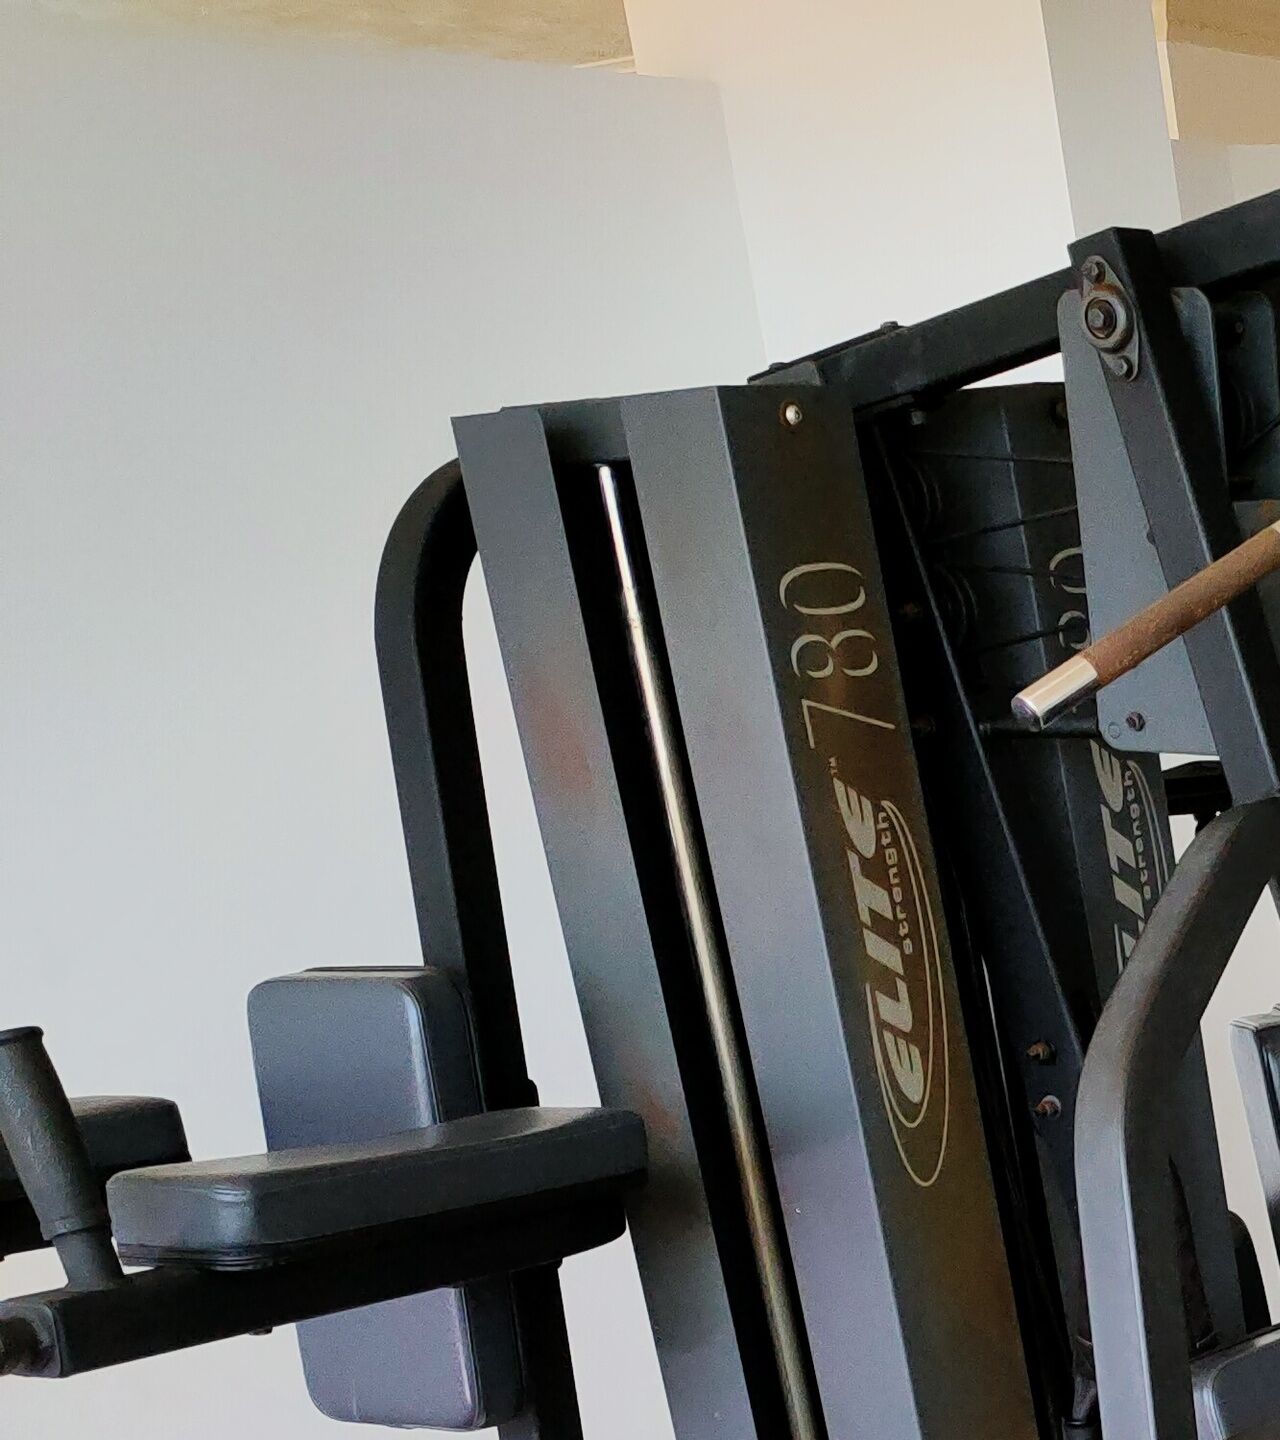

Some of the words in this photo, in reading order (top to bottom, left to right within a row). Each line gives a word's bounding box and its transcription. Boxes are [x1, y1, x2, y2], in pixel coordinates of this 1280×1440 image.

[779, 560, 896, 750] 780
[876, 808, 913, 956] strength
[1090, 738, 1145, 958] LITE
[1123, 770, 1152, 900] strength
